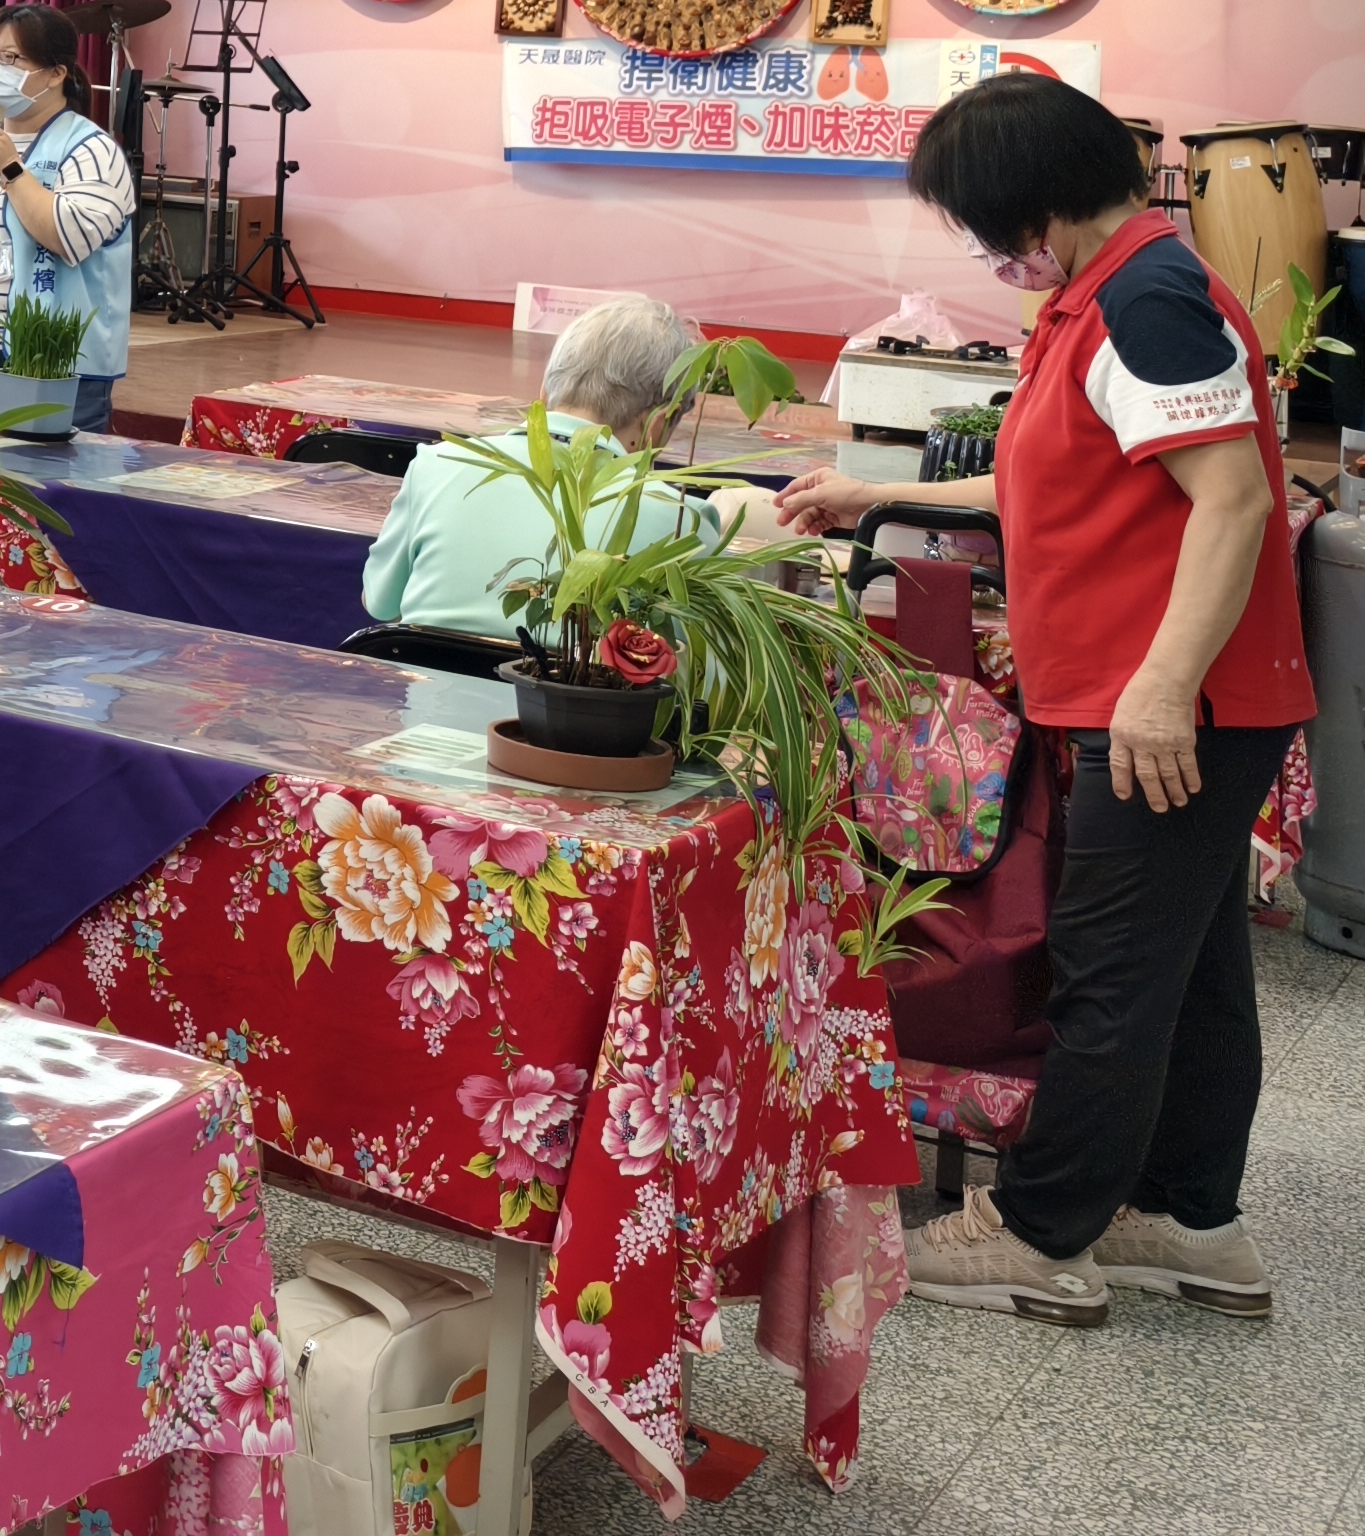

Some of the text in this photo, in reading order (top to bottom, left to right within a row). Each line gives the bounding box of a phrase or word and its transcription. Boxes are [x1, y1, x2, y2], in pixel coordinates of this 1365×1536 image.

[518, 48, 607, 66] 天晟醫院
[621, 48, 810, 94] 捍衛健康
